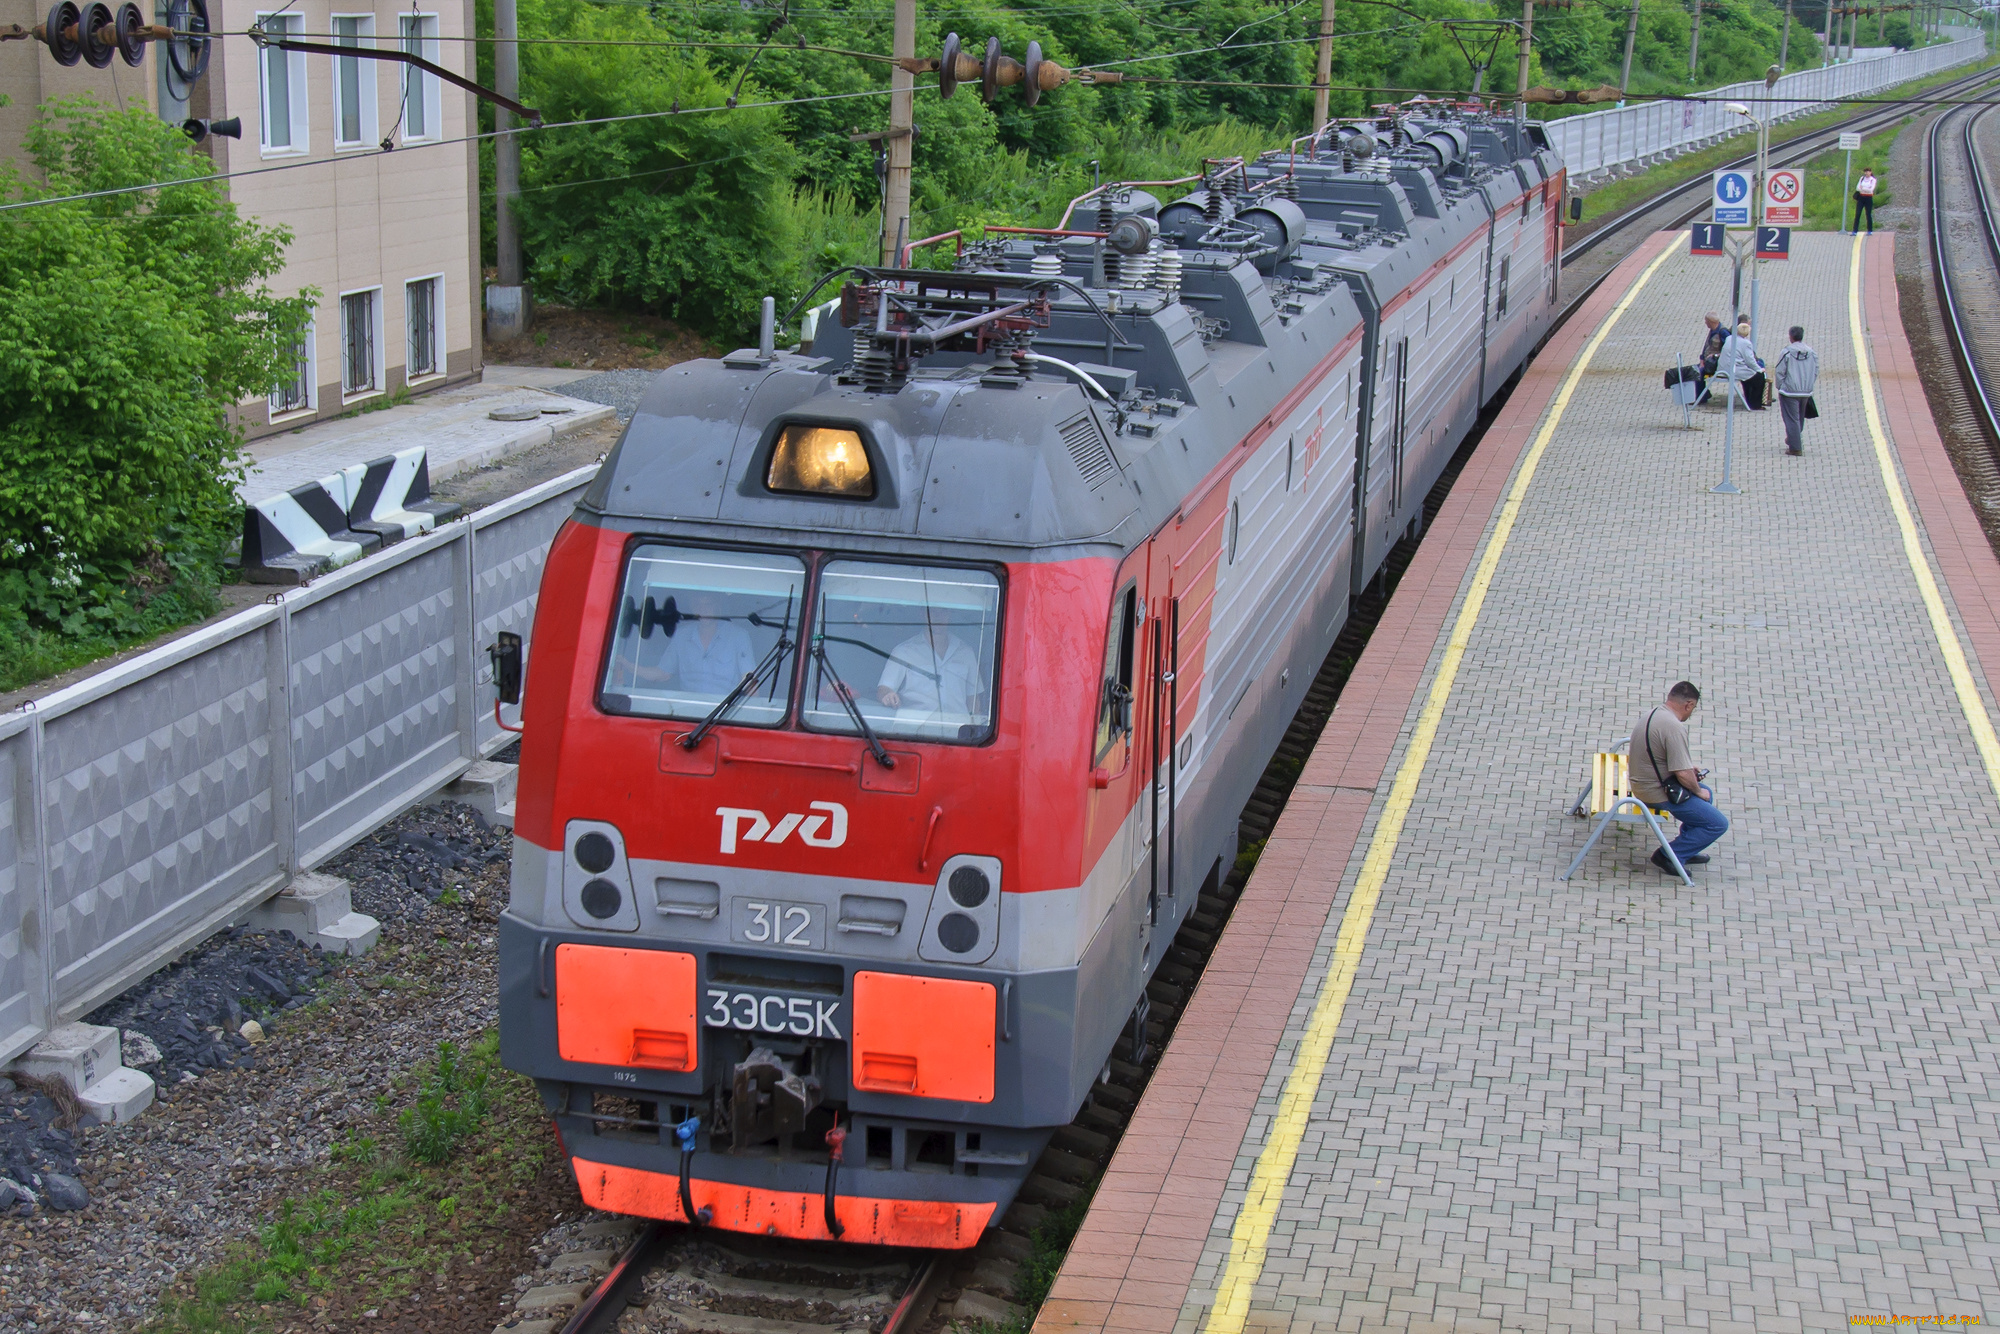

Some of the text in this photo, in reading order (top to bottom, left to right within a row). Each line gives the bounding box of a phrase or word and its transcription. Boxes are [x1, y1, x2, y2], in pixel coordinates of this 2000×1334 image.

[1703, 225, 1712, 245] 1
[1766, 227, 1780, 248] 2
[744, 902, 812, 947] 312
